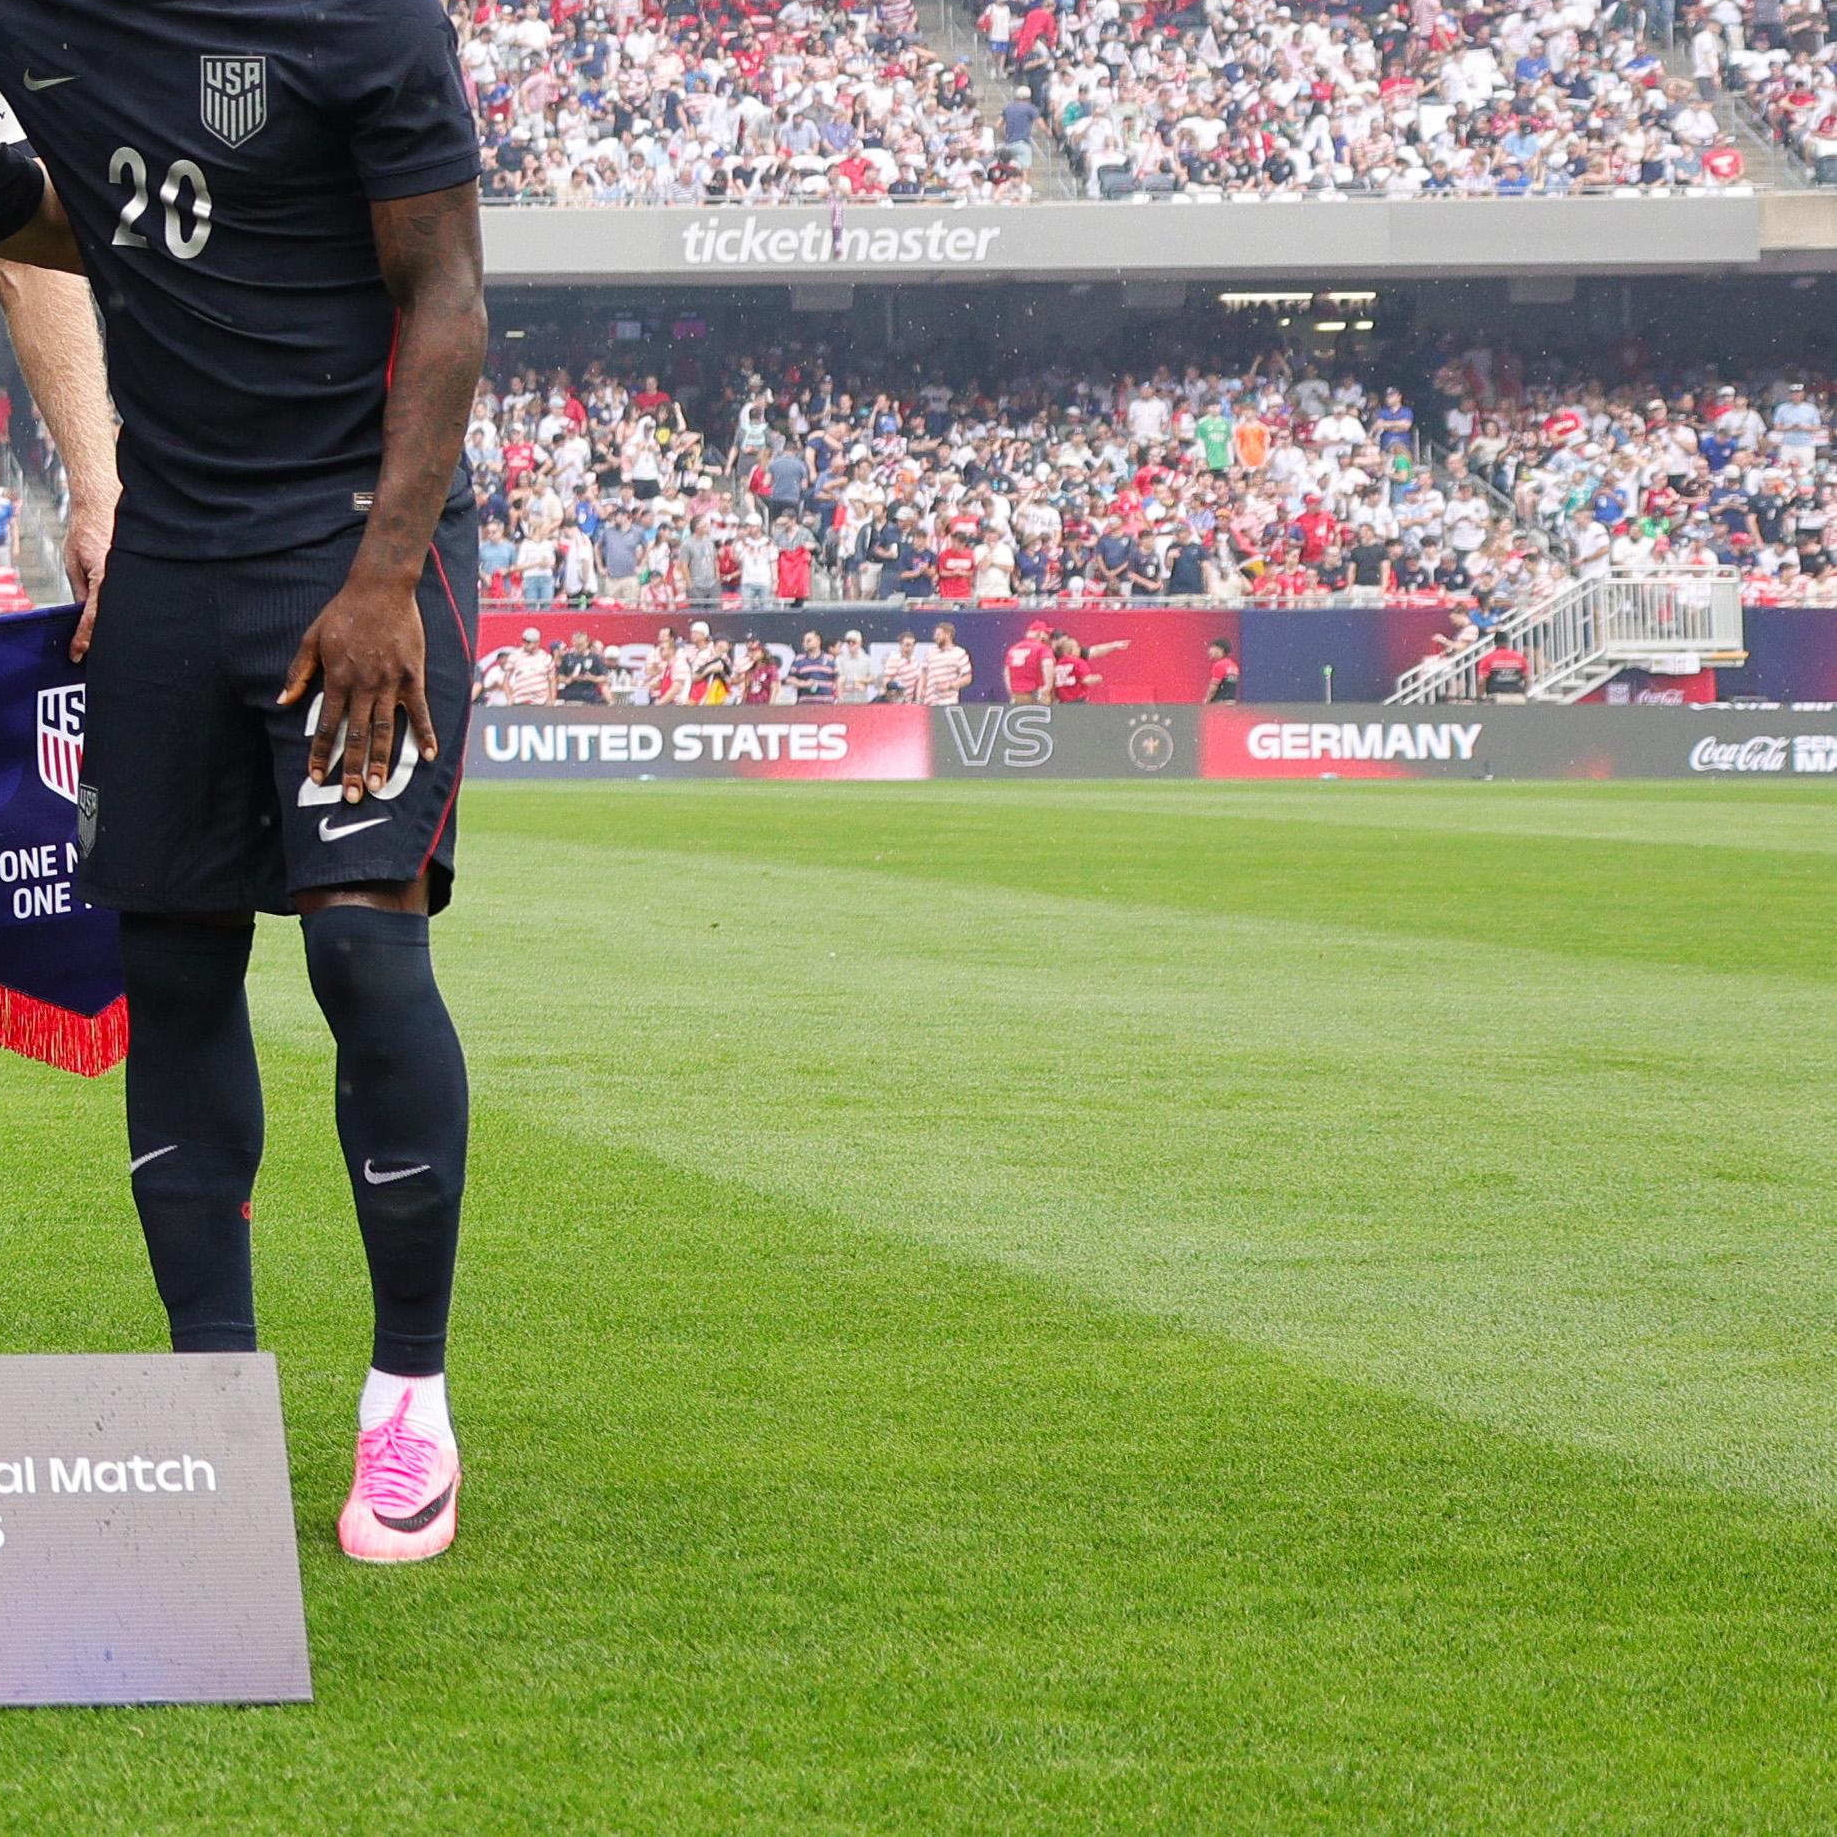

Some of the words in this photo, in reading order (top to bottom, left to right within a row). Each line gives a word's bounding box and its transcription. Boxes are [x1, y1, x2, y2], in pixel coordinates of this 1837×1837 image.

[206, 61, 260, 95] USA
[108, 147, 213, 259] 20
[682, 215, 1001, 265] ticketmaster
[485, 724, 666, 762] UNITED
[673, 724, 848, 761] STATES
[945, 705, 1055, 767] VS
[1247, 723, 1482, 760] GERMANY
[1689, 736, 1791, 771] Coca-Cola
[0, 844, 57, 884] ONE
[13, 880, 71, 920] ONE
[50, 1455, 217, 1493] Match
